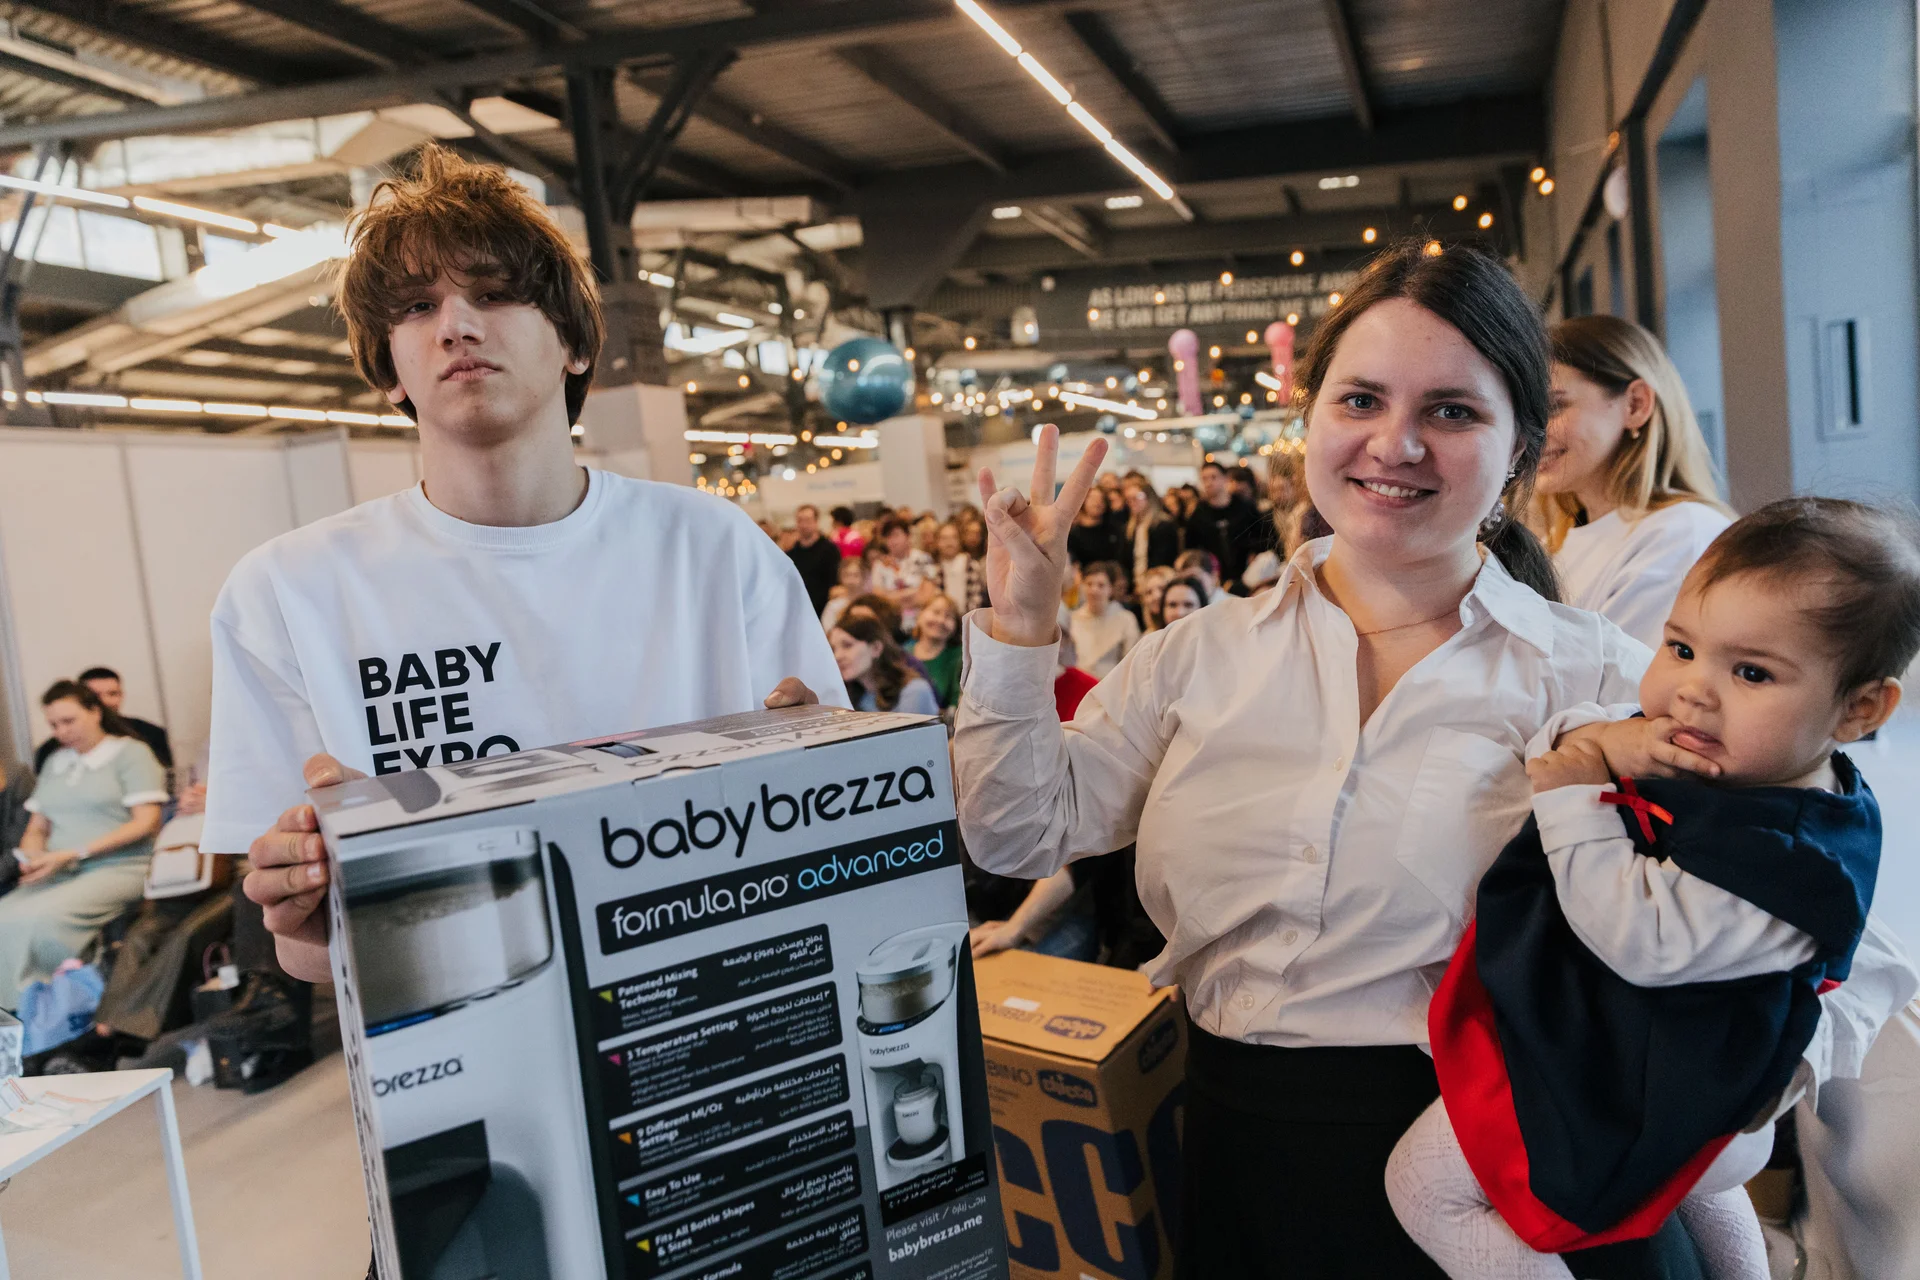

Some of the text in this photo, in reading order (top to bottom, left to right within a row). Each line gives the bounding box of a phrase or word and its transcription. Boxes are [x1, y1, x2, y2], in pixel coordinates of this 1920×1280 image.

[358, 642, 502, 699] BABY
[365, 692, 474, 746] LIFE
[611, 885, 735, 939] formula
[797, 829, 944, 890] advanced
[618, 968, 698, 997] Patented Mixing
[619, 986, 678, 1010] Technology
[627, 1050, 633, 1060] 3
[634, 1031, 699, 1057] Temperature
[700, 1019, 739, 1037] Settings
[638, 1129, 679, 1149] Settings
[646, 1113, 690, 1136] Different
[645, 1186, 667, 1200] Easy
[668, 1180, 682, 1190] To
[682, 1173, 702, 1186] Use
[655, 1201, 755, 1246] Fits All Bottle Shapes
[886, 1222, 918, 1242] Please
[920, 1212, 940, 1228] visit
[668, 1237, 692, 1253] Sizes
[888, 1214, 983, 1264] babybrezza.me
